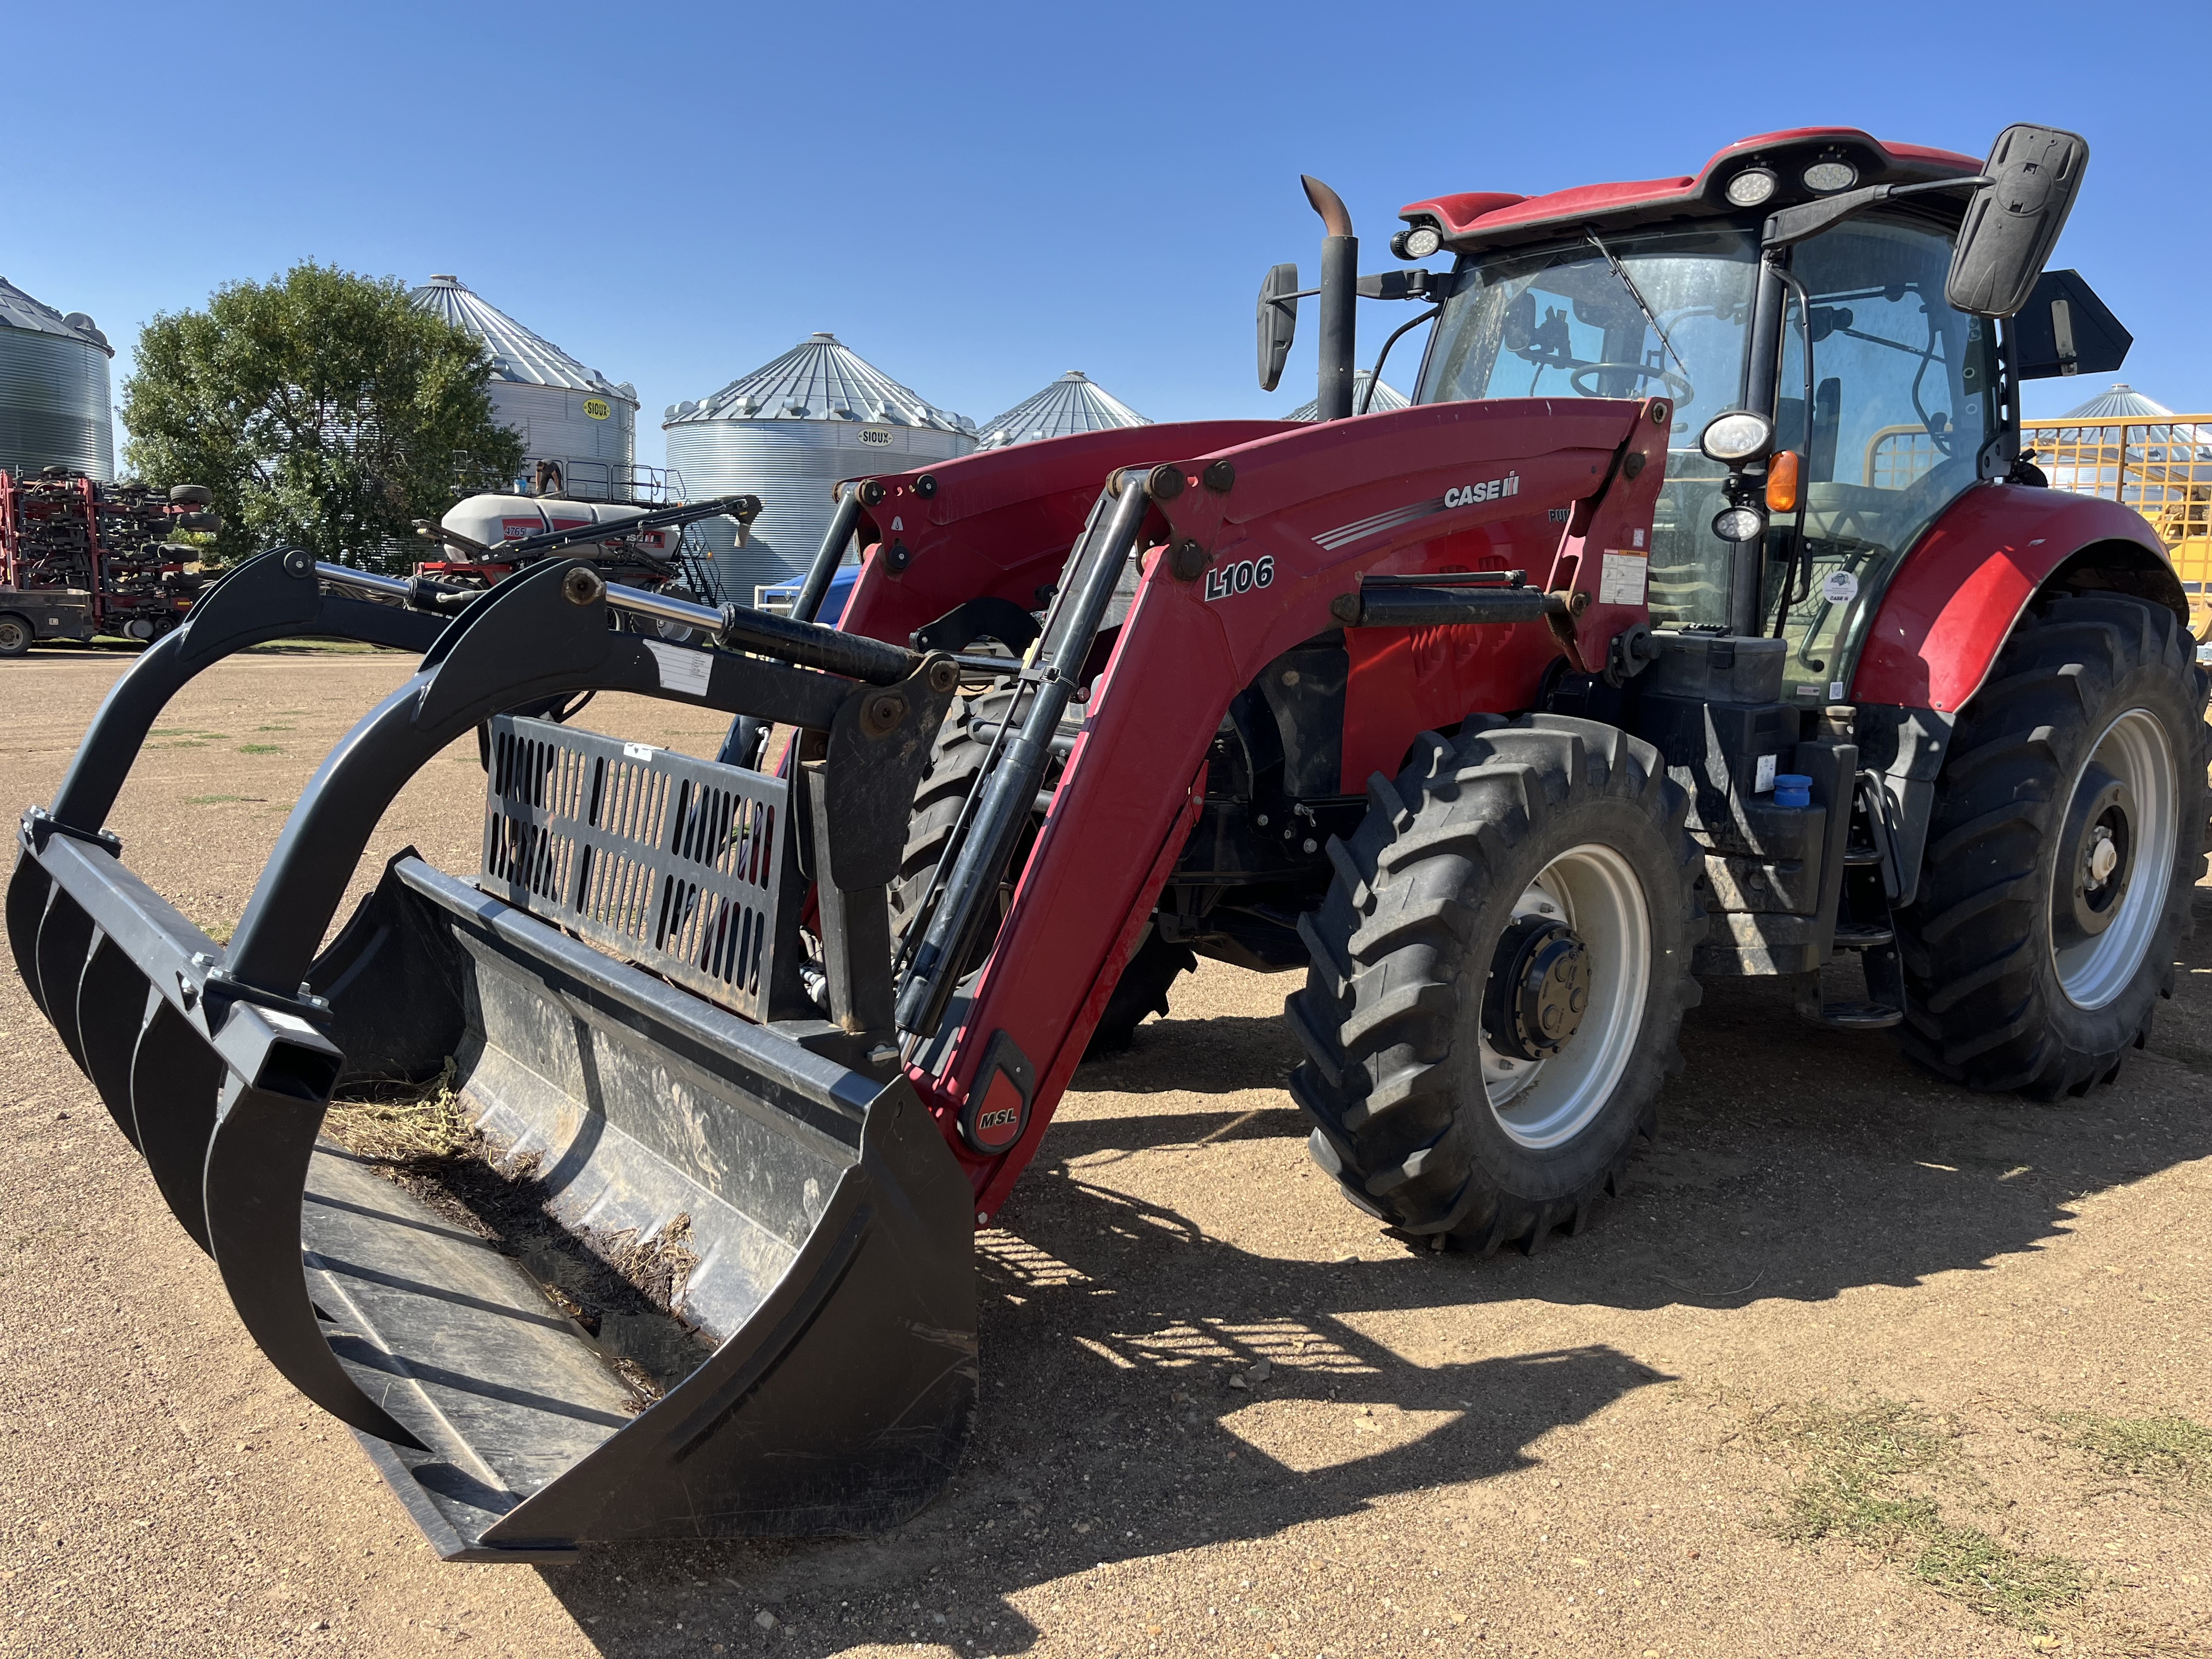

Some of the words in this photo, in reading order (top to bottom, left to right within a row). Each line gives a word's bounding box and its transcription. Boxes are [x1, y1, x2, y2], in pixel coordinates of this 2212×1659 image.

[588, 402, 607, 417] SIOUX
[863, 431, 889, 443] SIOUX
[1444, 479, 1500, 509] CASE
[1548, 509, 1571, 523] PUM
[505, 527, 526, 537] 4765
[1205, 555, 1275, 602] L106
[979, 1108, 1017, 1130] MSL
